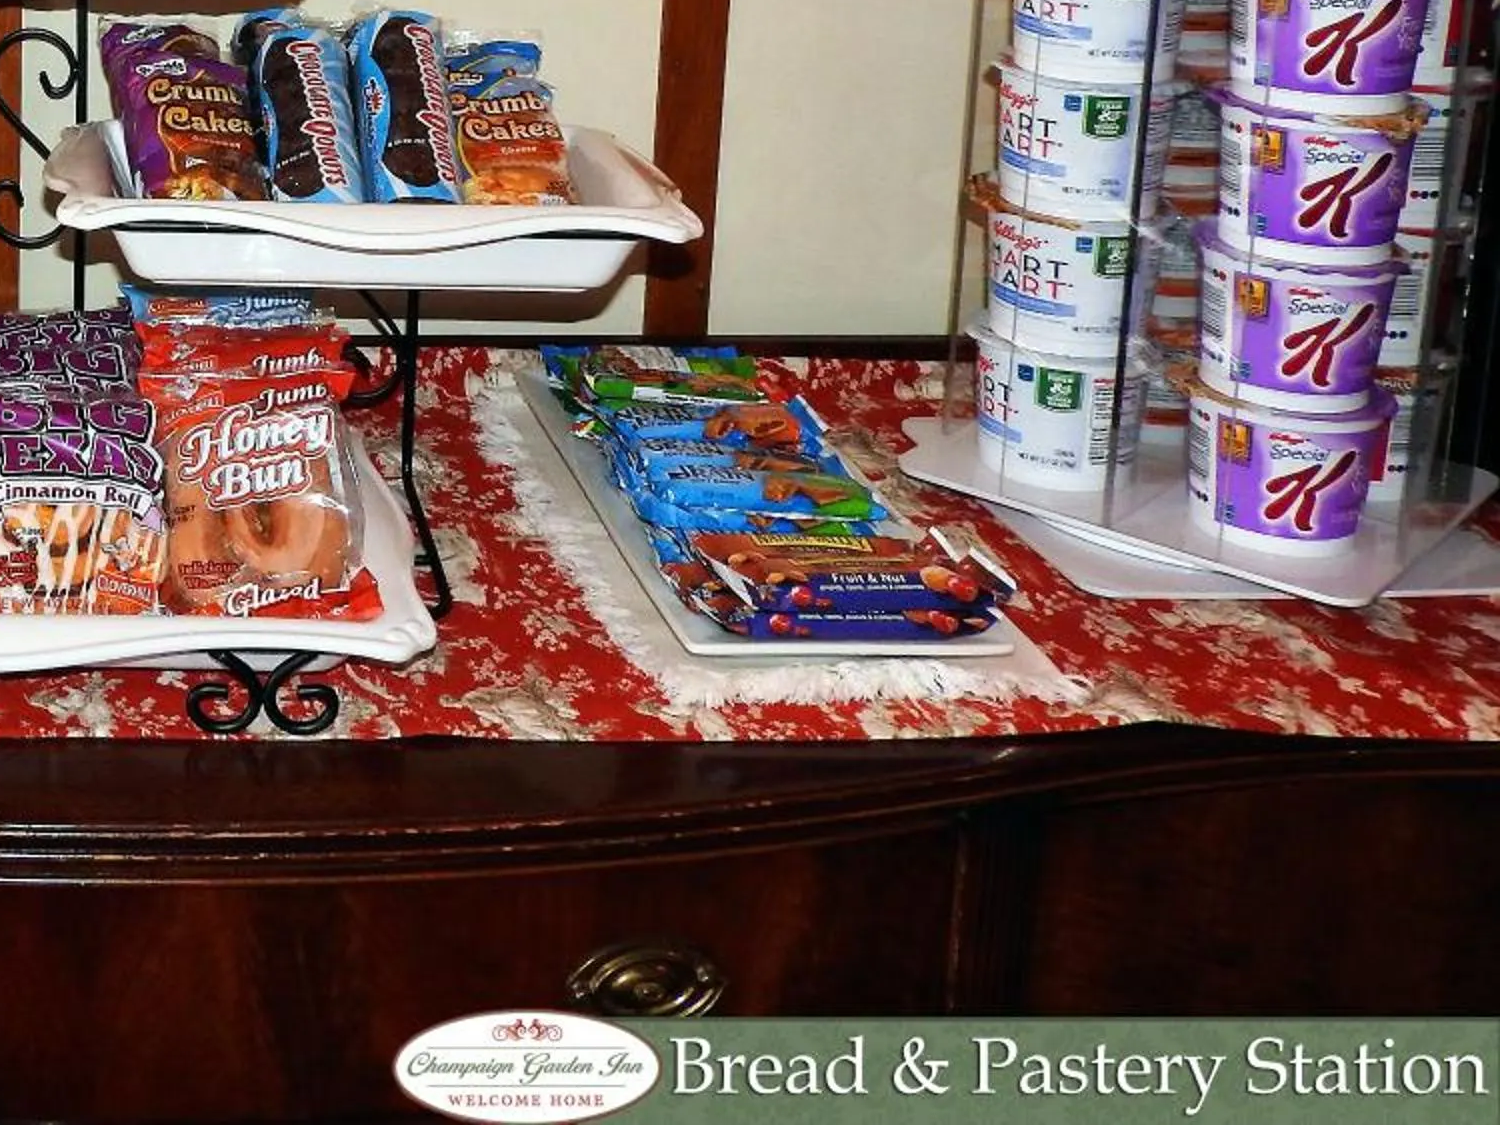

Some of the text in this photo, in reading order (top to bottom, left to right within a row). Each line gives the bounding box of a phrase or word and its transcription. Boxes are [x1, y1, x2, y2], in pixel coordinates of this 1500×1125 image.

[450, 91, 545, 116] Crumb
[164, 106, 253, 136] Cakes
[464, 116, 560, 141] Cakes
[1305, 148, 1367, 164] Special
[1297, 152, 1393, 239] K
[1288, 299, 1349, 315] Special
[1281, 303, 1375, 387] K
[258, 383, 331, 415] Jumb
[182, 405, 334, 477] Honey
[1270, 444, 1331, 461] Special
[212, 459, 307, 501] Bun
[1264, 450, 1358, 532] K
[104, 488, 142, 510] Roll
